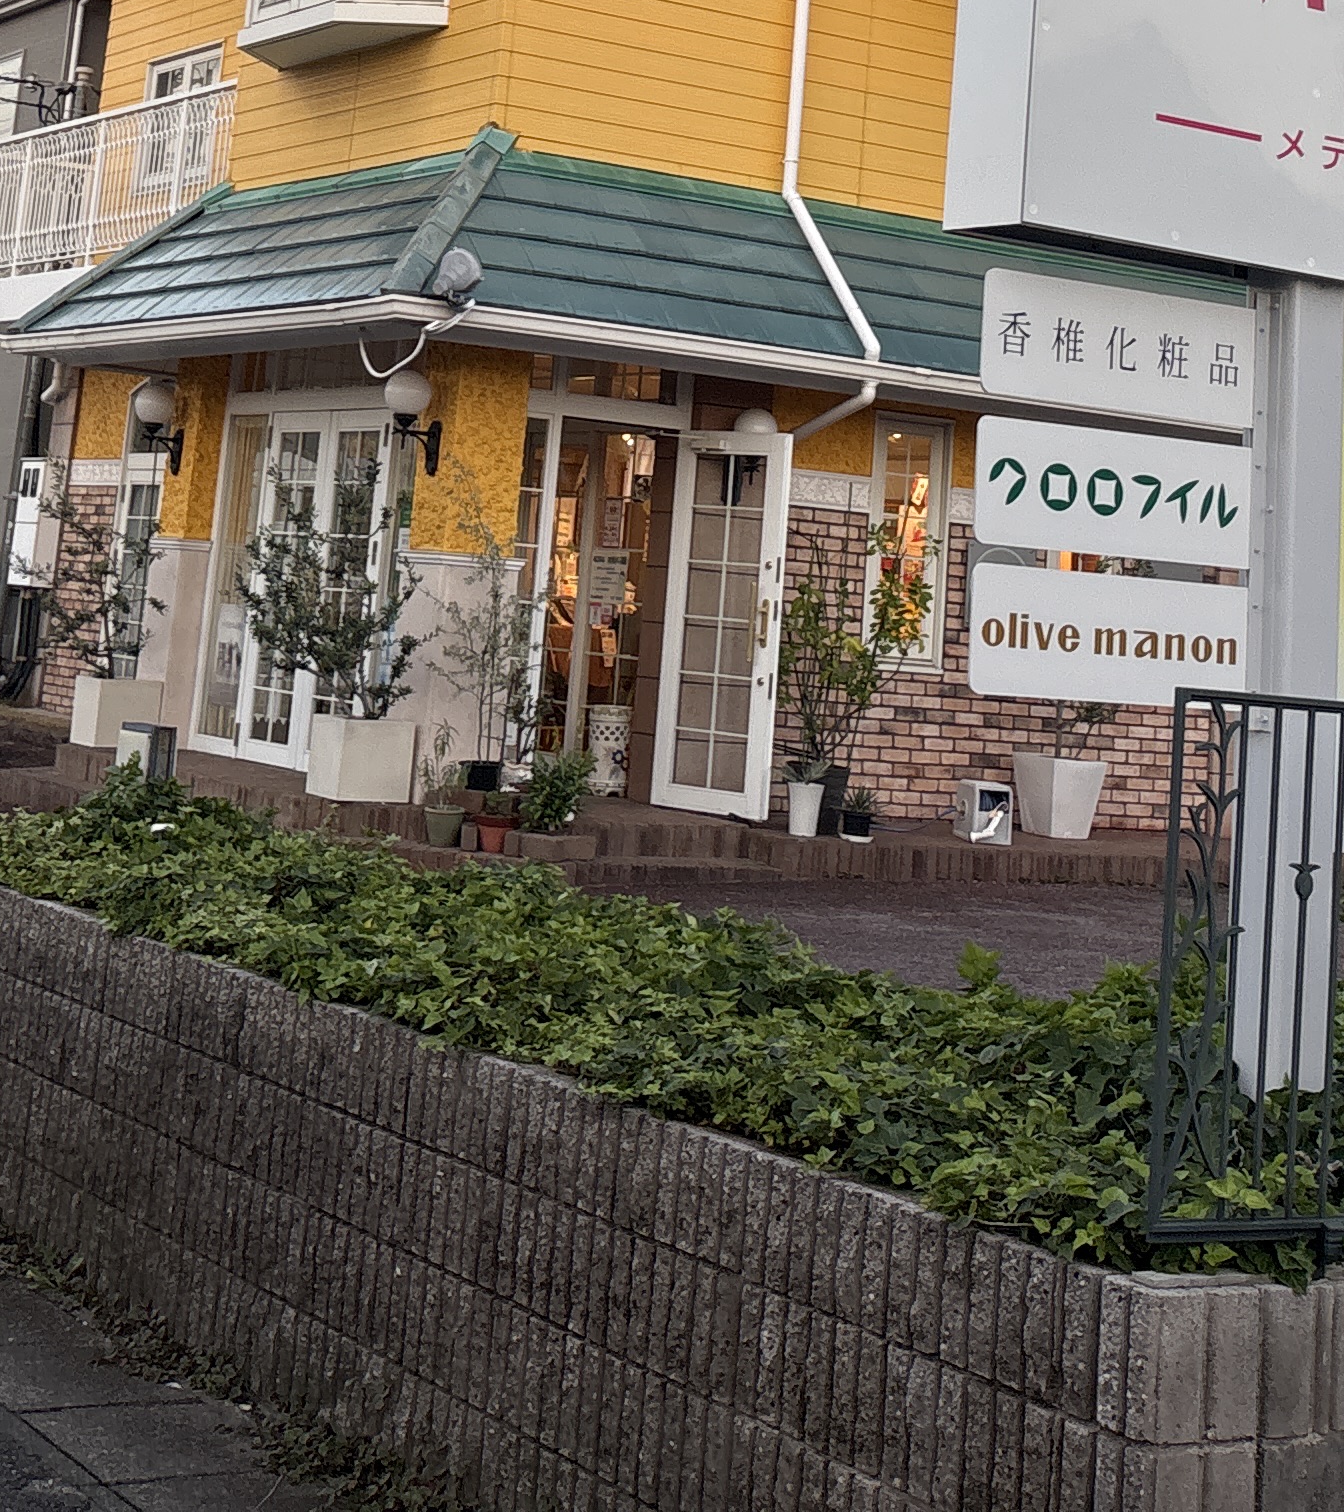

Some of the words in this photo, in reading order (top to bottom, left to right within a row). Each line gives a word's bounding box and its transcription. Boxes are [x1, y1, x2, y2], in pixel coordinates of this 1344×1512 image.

[997, 310, 1240, 388] 香椎化粧品
[981, 611, 1082, 654] olive
[1093, 627, 1238, 666] manon
